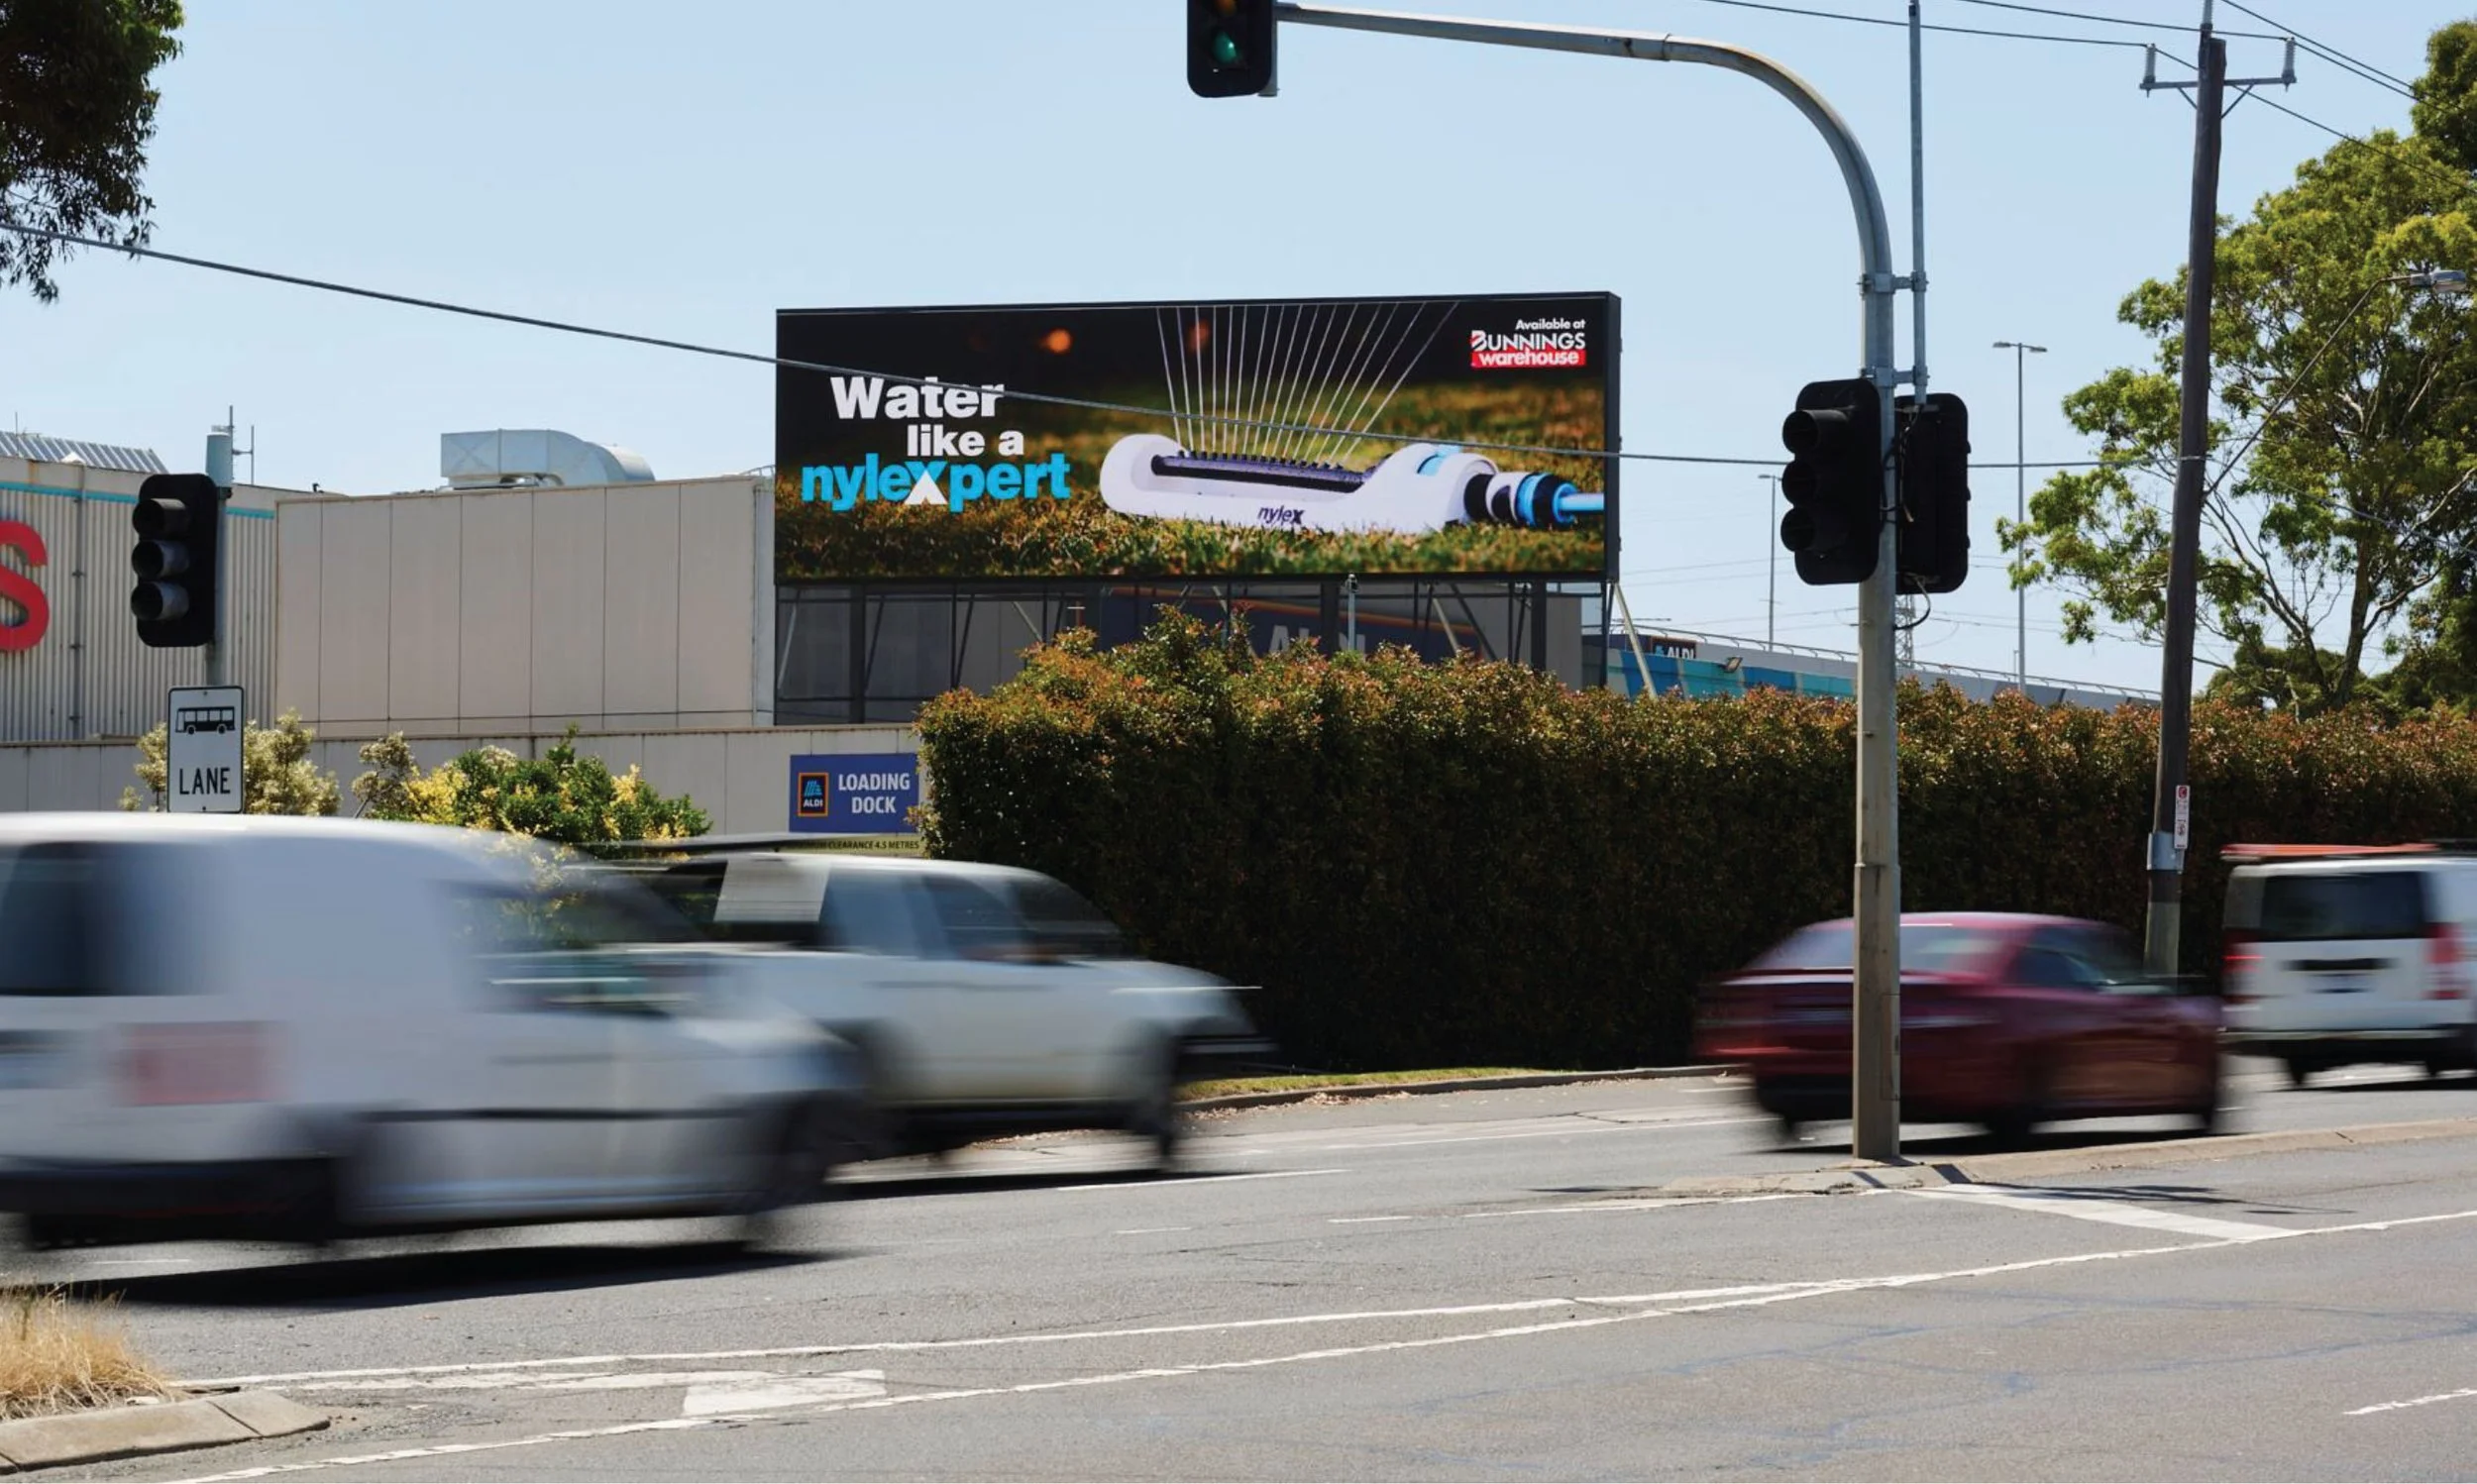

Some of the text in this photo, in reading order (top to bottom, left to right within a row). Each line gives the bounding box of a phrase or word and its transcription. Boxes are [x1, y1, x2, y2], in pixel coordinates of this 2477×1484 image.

[1515, 317, 1585, 330] Available at
[1471, 330, 1585, 351] BUNNINGS
[1479, 347, 1579, 366] warehouse
[829, 375, 1005, 419] Water
[908, 424, 1023, 456] like a
[1257, 504, 1305, 525] nylex
[179, 767, 231, 795] LANE
[838, 773, 911, 791] LOADING
[804, 798, 823, 807] ALDI
[851, 795, 897, 813] DOCK
[828, 840, 873, 849] CLEARANCE
[875, 840, 887, 849] 4.5
[888, 840, 919, 849] METRES
